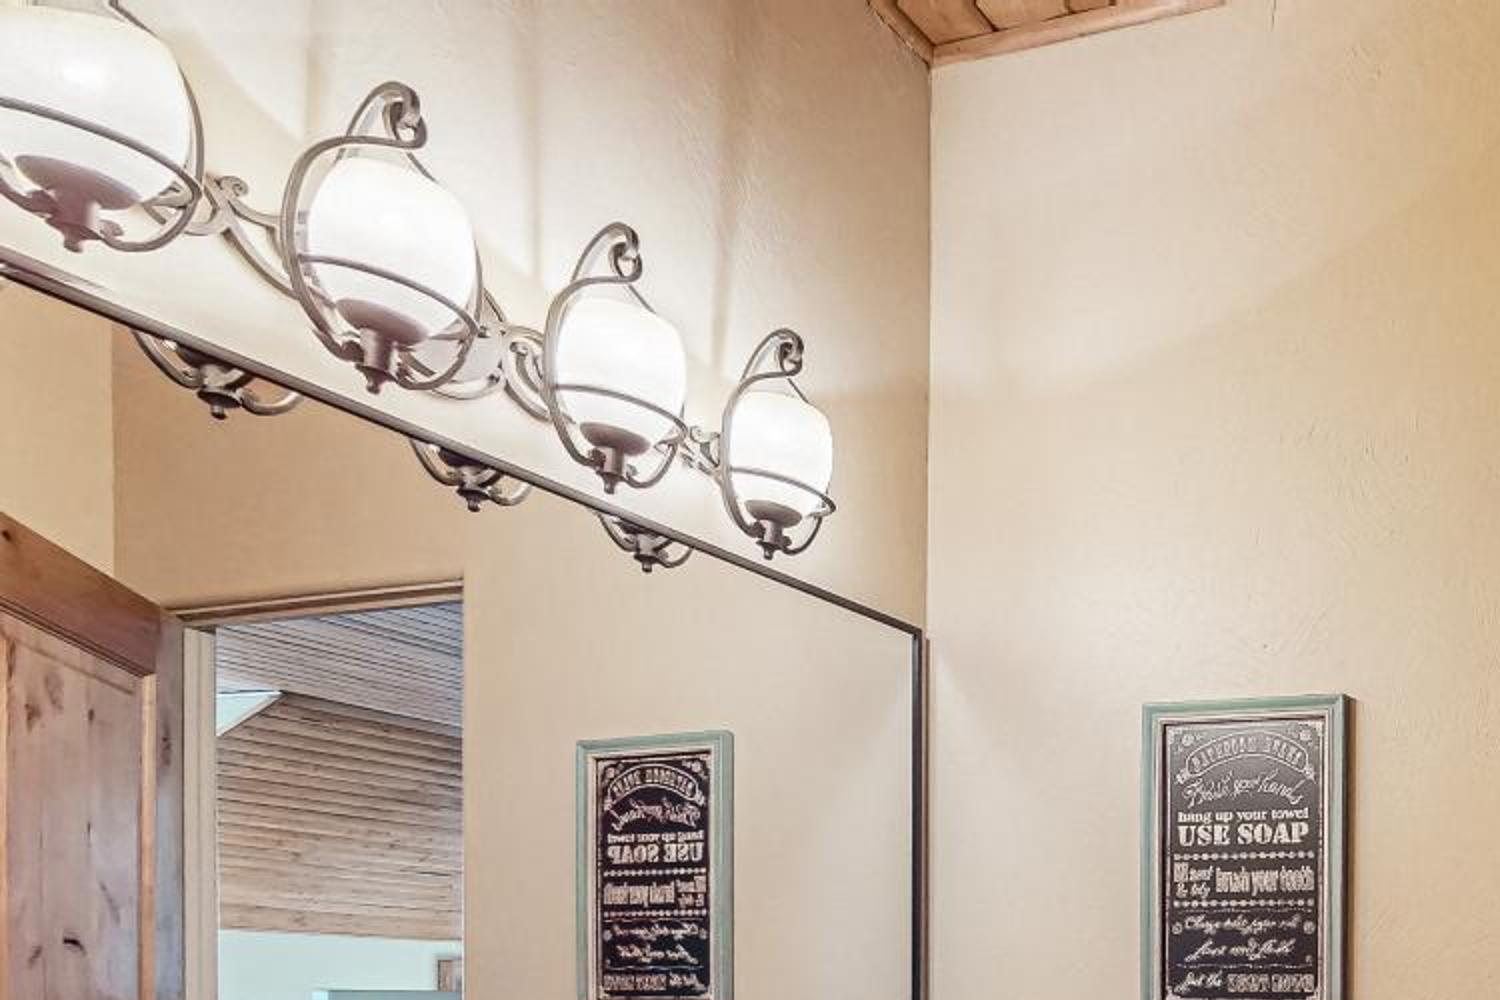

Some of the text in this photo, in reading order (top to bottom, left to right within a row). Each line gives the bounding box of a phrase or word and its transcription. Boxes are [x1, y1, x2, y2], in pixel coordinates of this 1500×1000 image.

[1177, 807, 1309, 824] hang up your towel
[1177, 821, 1309, 847] USE SOAP
